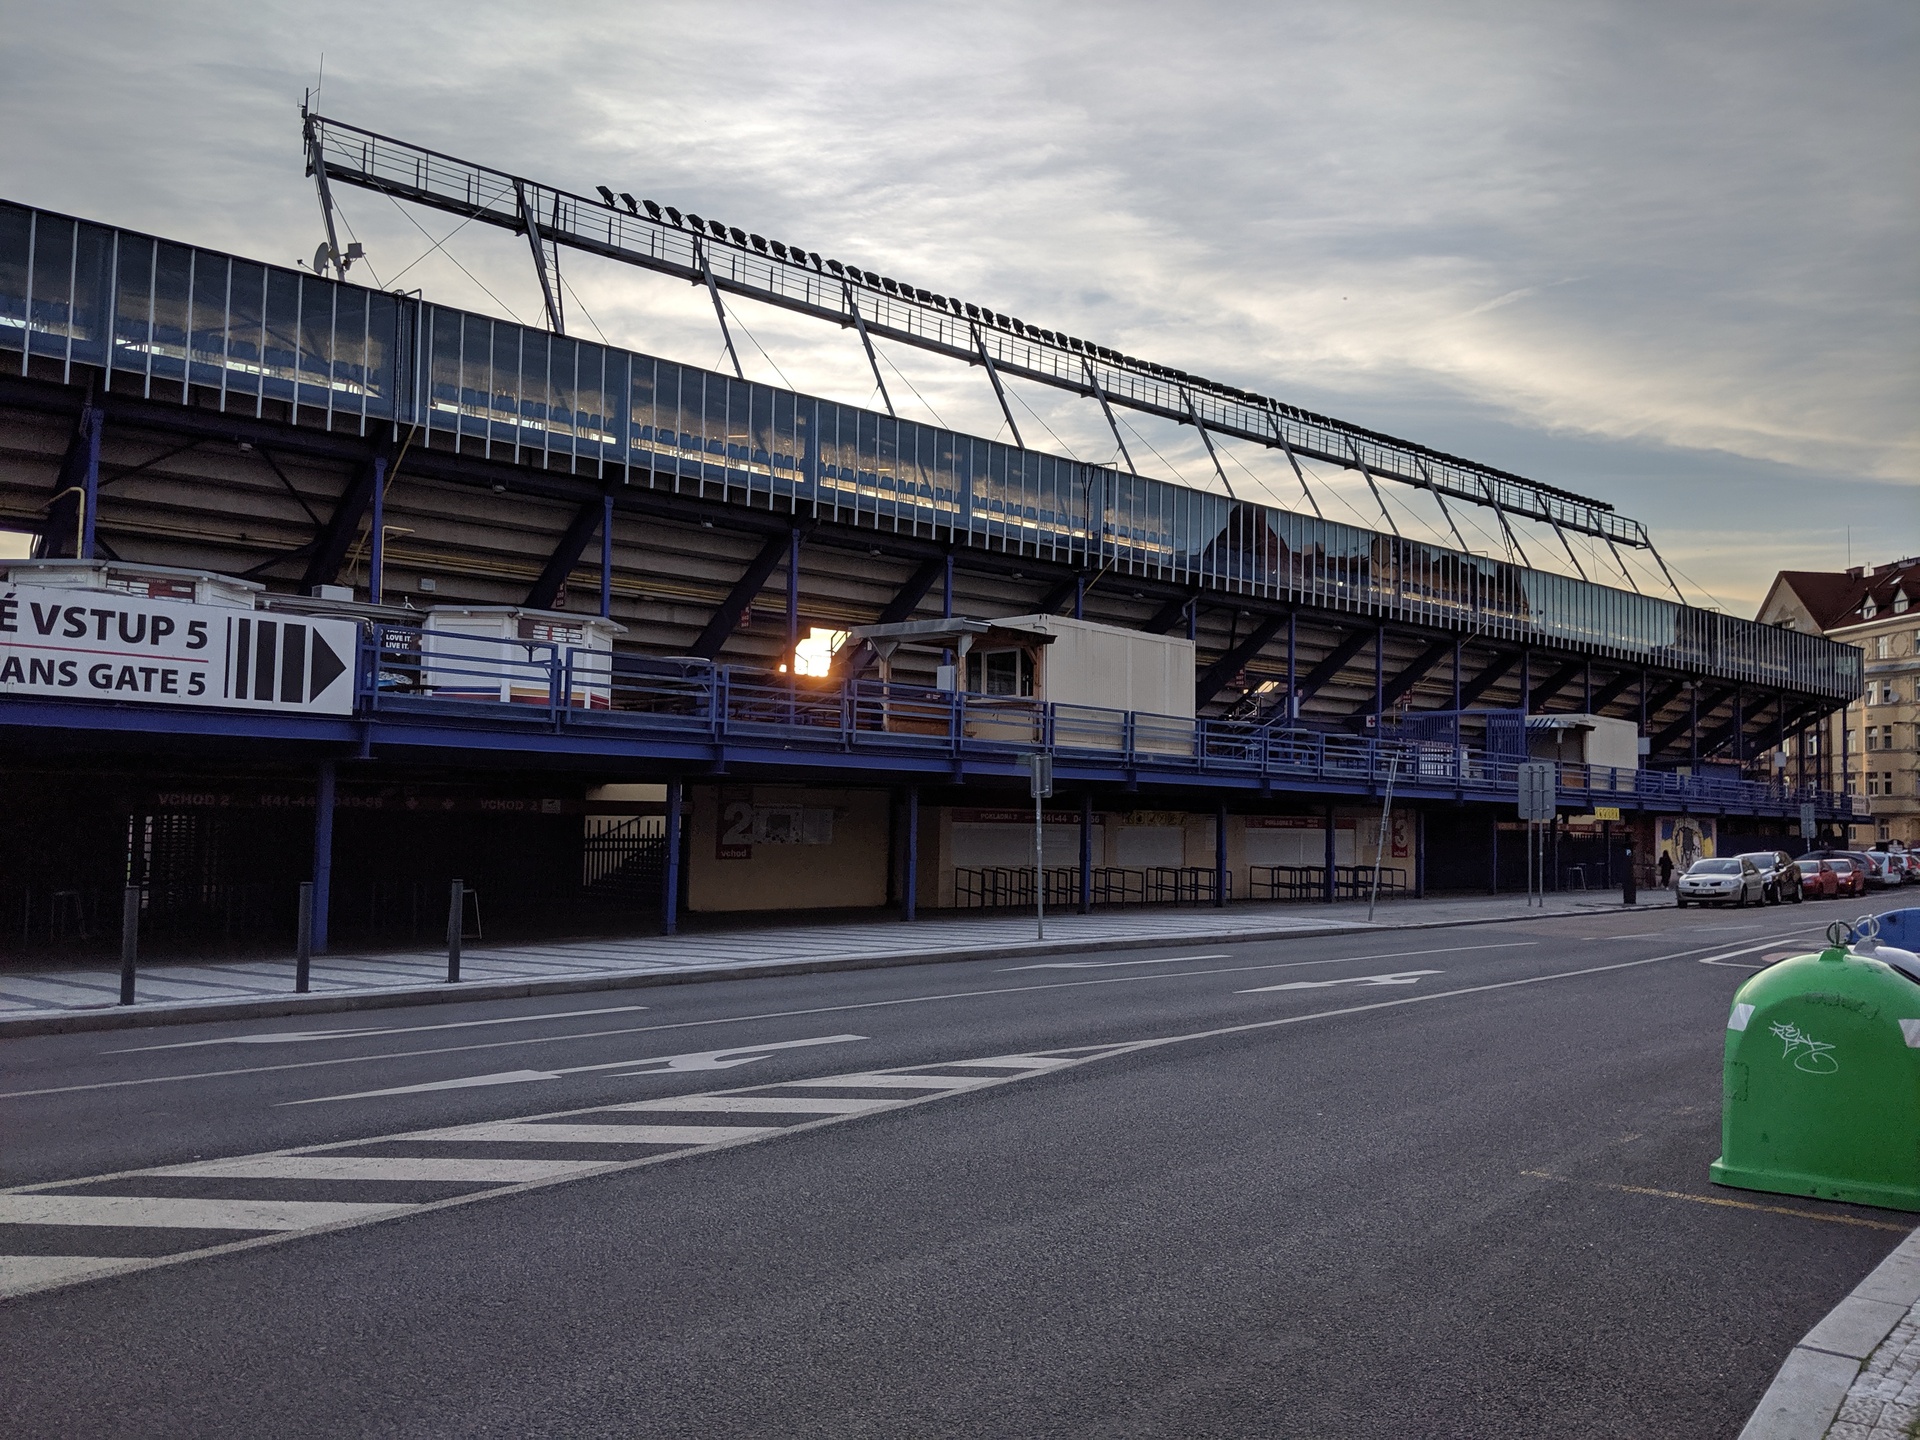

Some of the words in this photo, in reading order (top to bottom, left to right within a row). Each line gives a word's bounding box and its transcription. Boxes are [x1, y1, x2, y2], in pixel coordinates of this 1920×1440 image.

[30, 602, 175, 645] VSTUP
[186, 620, 208, 650] 5
[404, 635, 412, 643] IT.
[89, 663, 179, 694] GATE
[188, 672, 206, 696] 5
[157, 793, 215, 806] VCHOD
[220, 794, 230, 807] 2
[480, 798, 524, 810] VCHOD
[722, 801, 753, 845] 2
[1394, 819, 1408, 848] 3
[720, 849, 747, 858] vchod
